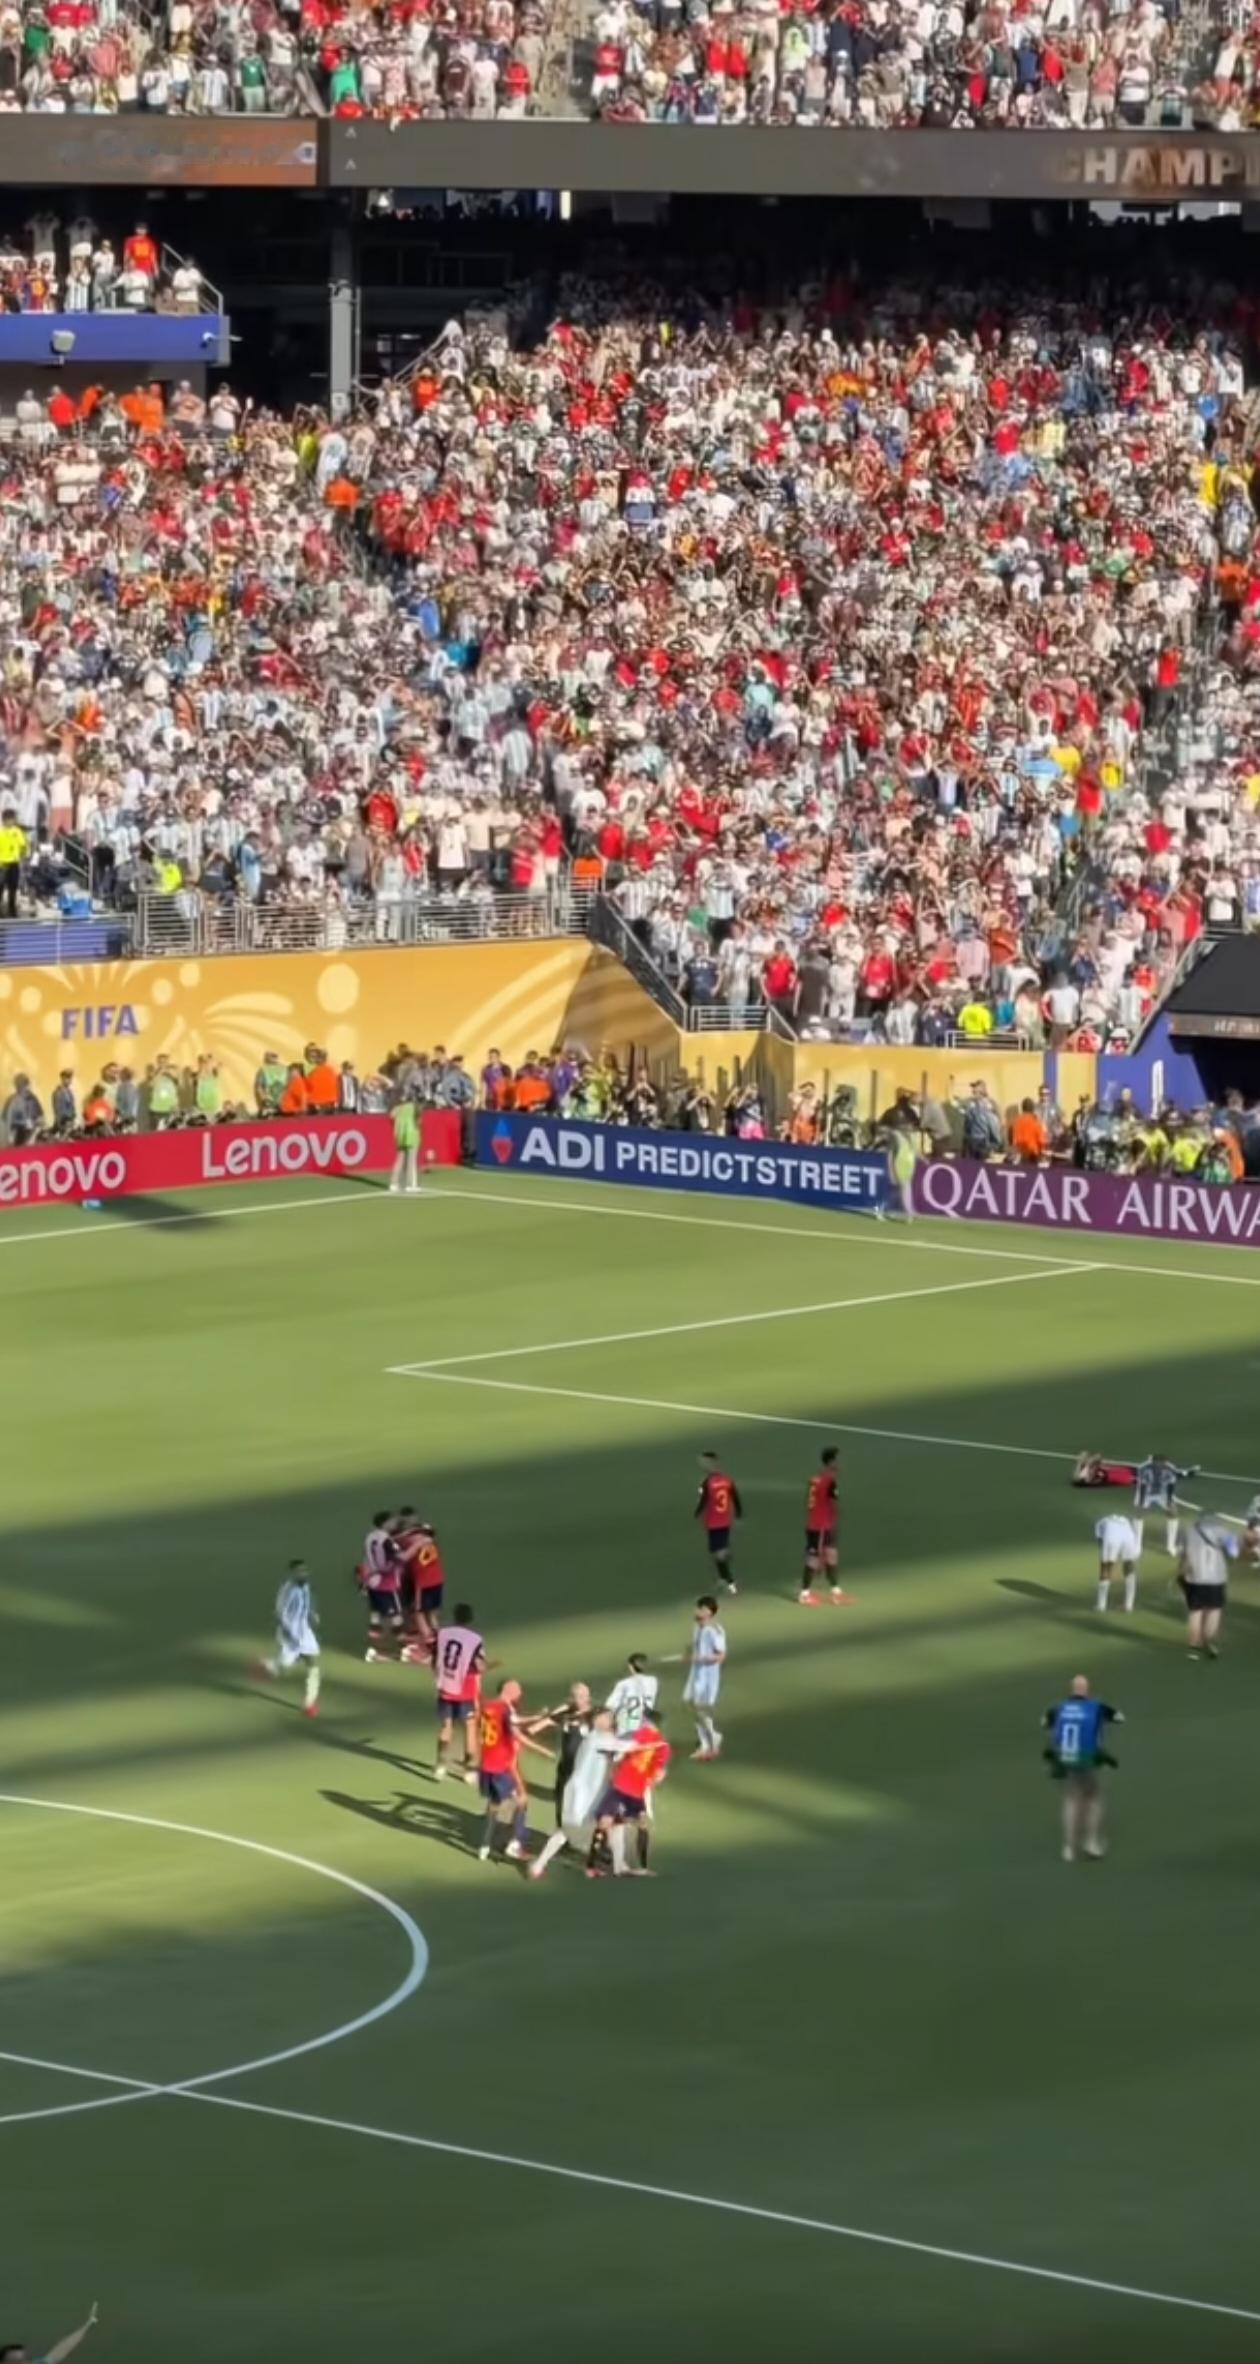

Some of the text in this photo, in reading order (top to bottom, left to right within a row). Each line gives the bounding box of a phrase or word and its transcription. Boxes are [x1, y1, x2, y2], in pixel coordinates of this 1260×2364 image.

[61, 1004, 139, 1040] FIFA
[202, 1130, 366, 1178] Lenovo
[520, 1127, 884, 1197] ADI PREDICTSTREET
[922, 1163, 1092, 1224] QATAR
[715, 1489, 729, 1513] 3
[444, 1639, 463, 1671] 0
